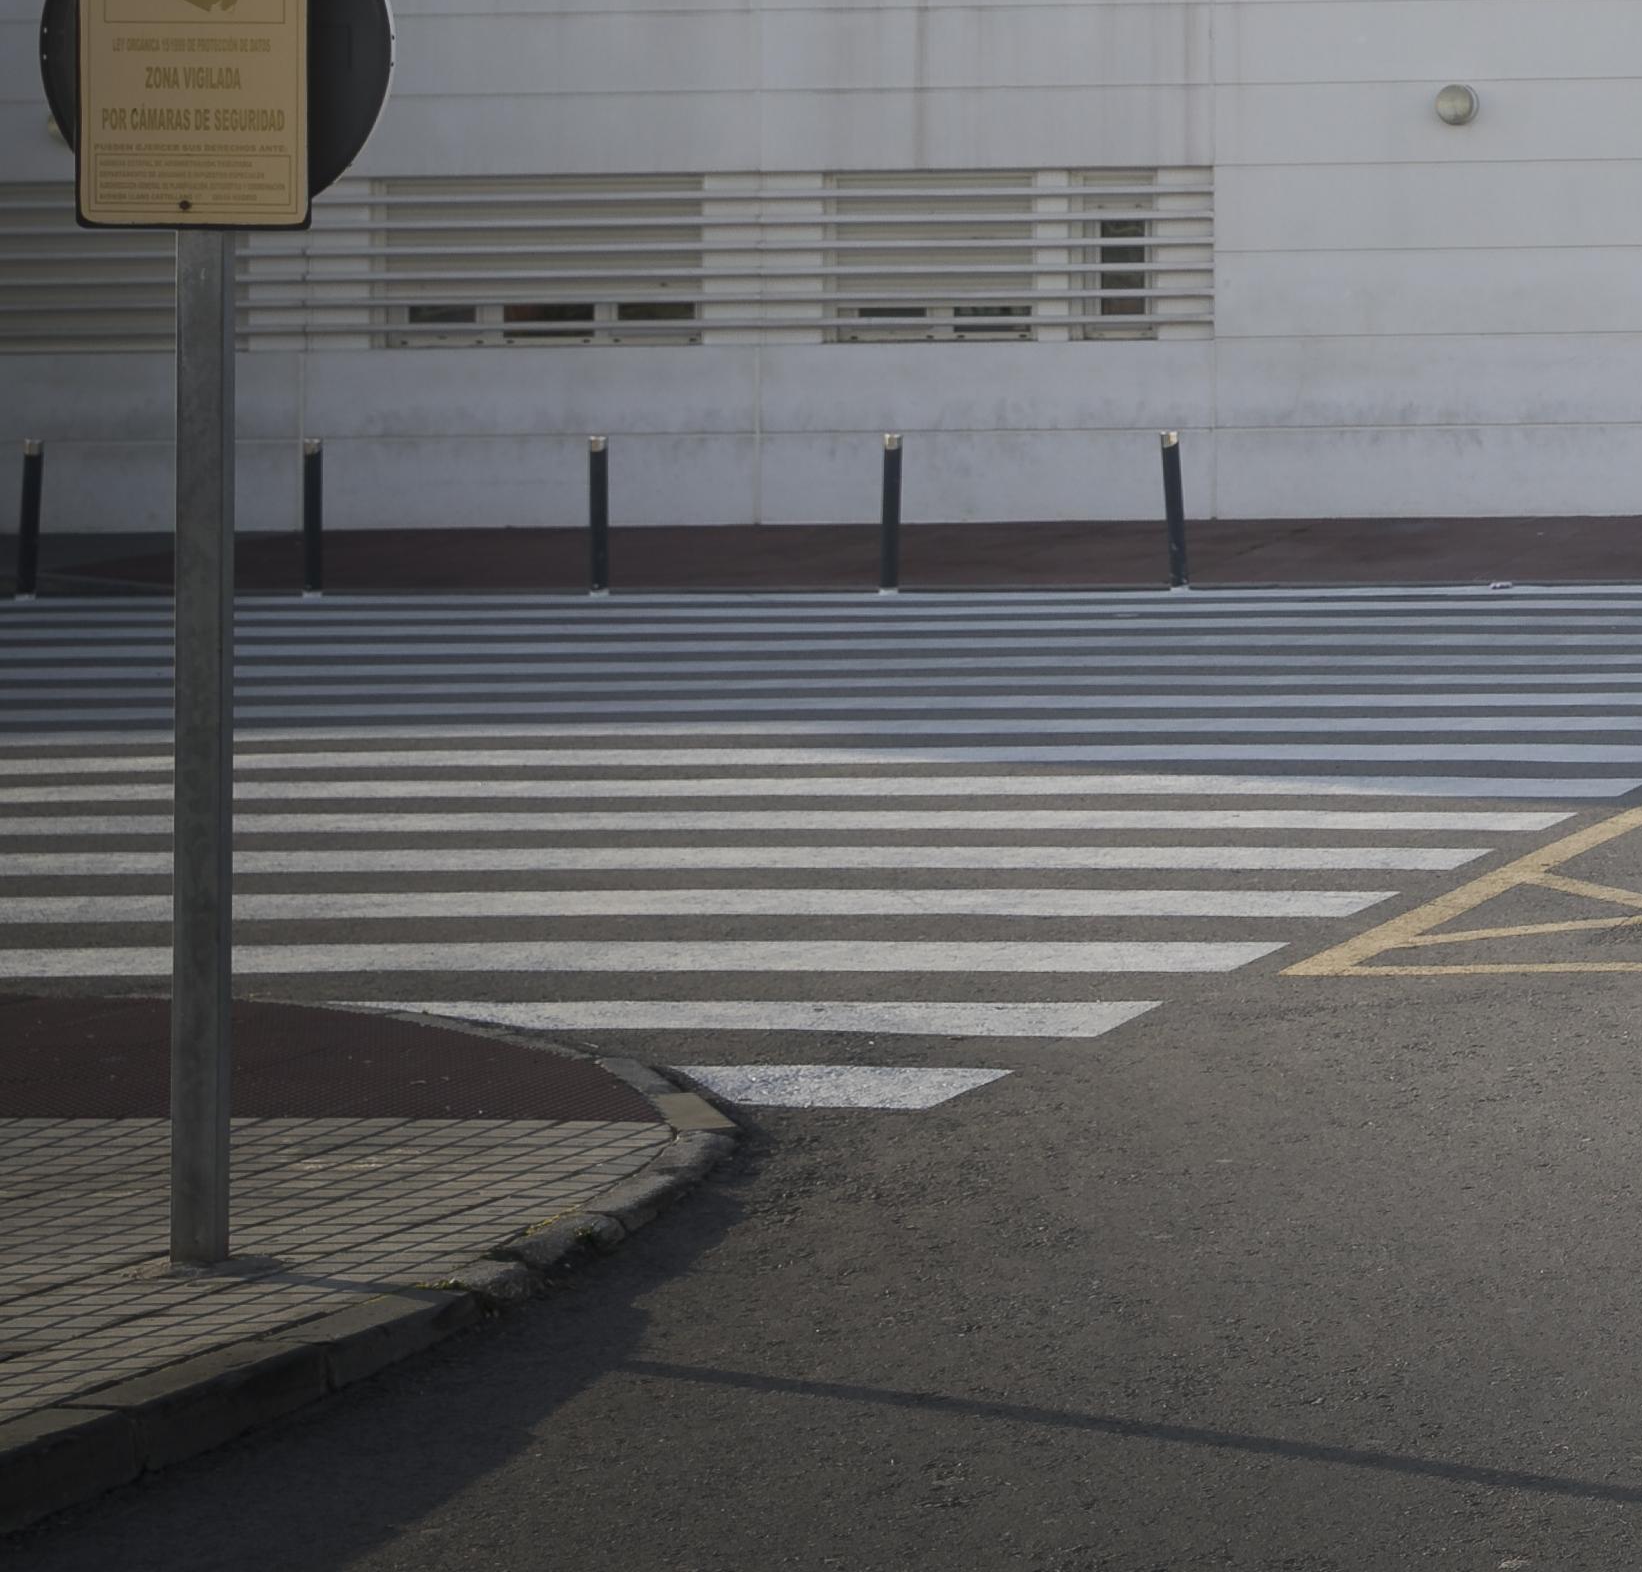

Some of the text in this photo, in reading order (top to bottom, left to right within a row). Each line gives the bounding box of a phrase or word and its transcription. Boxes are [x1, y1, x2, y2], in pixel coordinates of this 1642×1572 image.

[145, 66, 242, 90] ZONA VIGILADA
[102, 102, 286, 132] POR CÁMARAS DE SEGURIDAD
